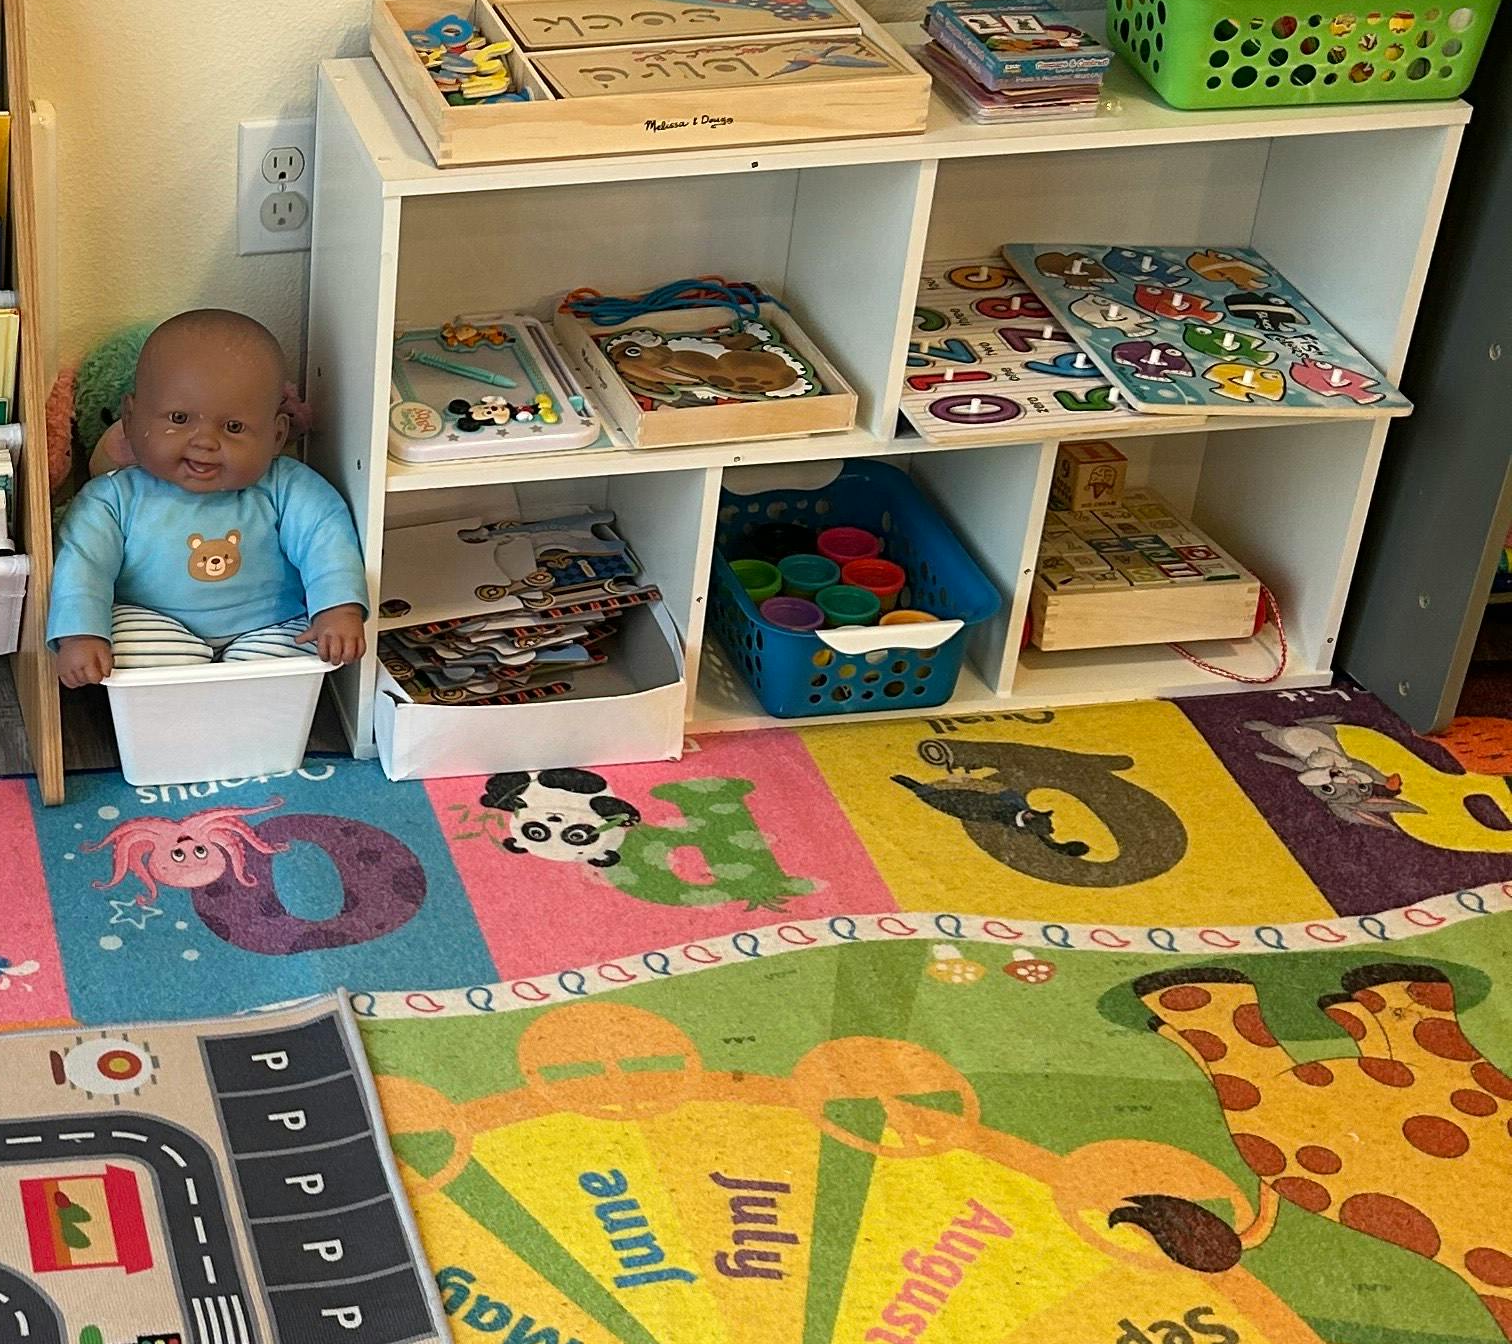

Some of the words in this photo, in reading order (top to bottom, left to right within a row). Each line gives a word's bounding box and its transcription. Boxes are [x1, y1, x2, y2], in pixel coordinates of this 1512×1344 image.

[644, 115, 688, 132] Melissa
[1000, 366, 1021, 383] one
[1028, 396, 1050, 414] zero
[252, 1051, 288, 1070] P
[268, 1110, 307, 1131] P
[285, 1173, 325, 1196] P
[578, 1167, 697, 1289] June
[708, 1171, 801, 1280] July
[303, 1239, 344, 1263] P
[321, 1305, 364, 1331] P
